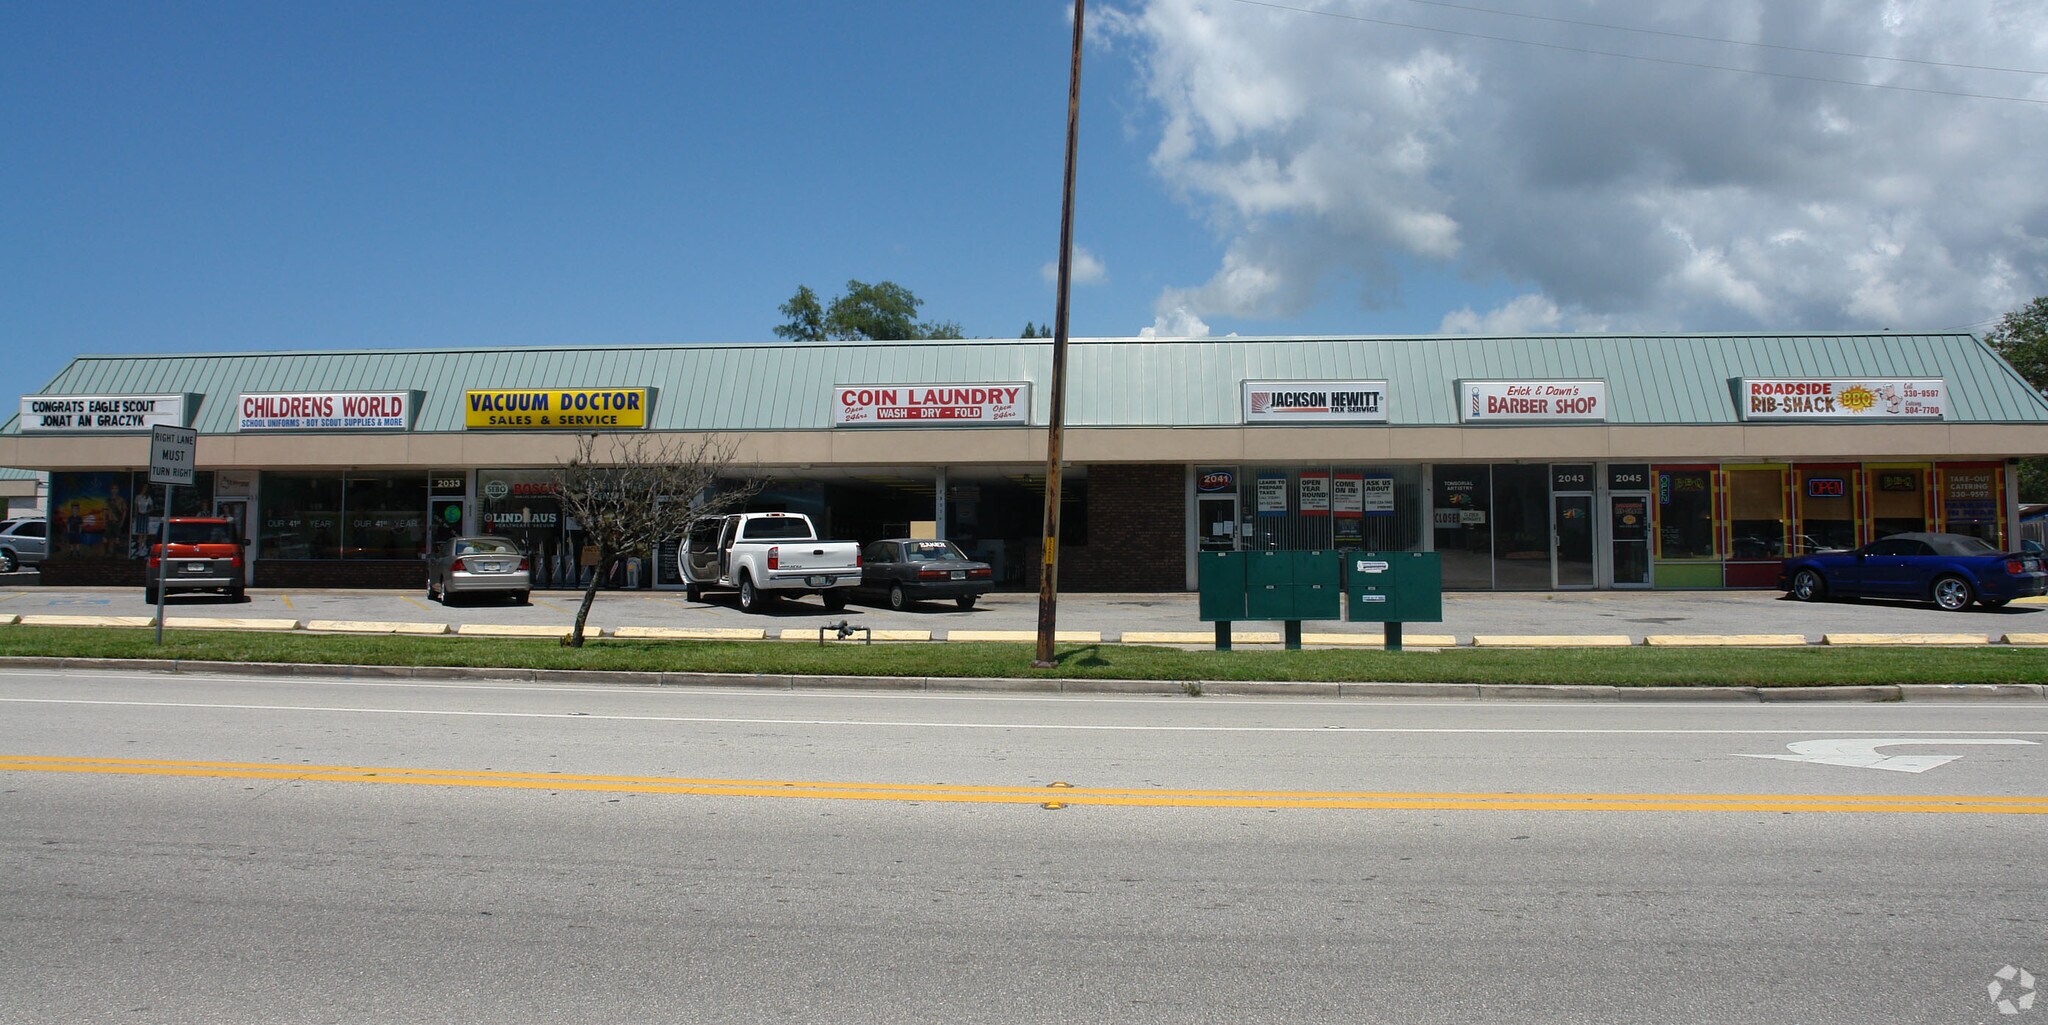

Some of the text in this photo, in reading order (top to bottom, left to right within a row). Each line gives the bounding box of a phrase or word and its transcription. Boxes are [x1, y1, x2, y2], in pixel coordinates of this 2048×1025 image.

[1507, 386, 1579, 396] Erick & Dawn's
[1751, 383, 1832, 395] ROADSIDE
[470, 393, 640, 411] VACUUM DOCTOR
[841, 388, 1020, 406] COIN LAUNDRY
[1271, 391, 1379, 407] JACKSON HEWITT
[1843, 393, 1872, 407] BBQ
[32, 400, 156, 413] CONGRATS EAGLE SCOUT
[243, 396, 403, 418] CHILDRENS WORLD
[1488, 395, 1597, 414] BARBER SHOP
[1751, 396, 1835, 413] RIB-SHACK
[845, 406, 864, 414] Open
[879, 409, 908, 418] WASH
[920, 408, 942, 418] DRY
[954, 408, 980, 417] FOLD
[1905, 406, 1939, 414] 504-7700
[40, 415, 144, 427] JONAT AN GRACZYK
[242, 419, 266, 428] SCHOOL
[268, 419, 300, 427] UNIFORMS
[306, 419, 318, 427] BOY
[321, 419, 342, 427] SCOUT
[344, 418, 375, 427] SUPPLIES
[377, 418, 382, 426] &
[383, 418, 403, 426] MORE
[489, 415, 617, 425] SALES & SERVICE
[155, 432, 194, 445] RIGHT LANE
[162, 450, 185, 461] MUST
[152, 466, 192, 477] TURN RIGHT
[1204, 475, 1228, 483] 2041
[1558, 475, 1584, 483] 2043
[1615, 474, 1642, 482] 2045
[437, 480, 461, 488] 2033
[1812, 481, 1842, 495] OPEN
[493, 513, 557, 523] LINDAUS
[1435, 513, 1461, 523] CLOSED
[268, 520, 284, 528] OUR
[310, 520, 331, 528] YEAR
[354, 520, 371, 528] OUR
[394, 520, 418, 528] YEAR
